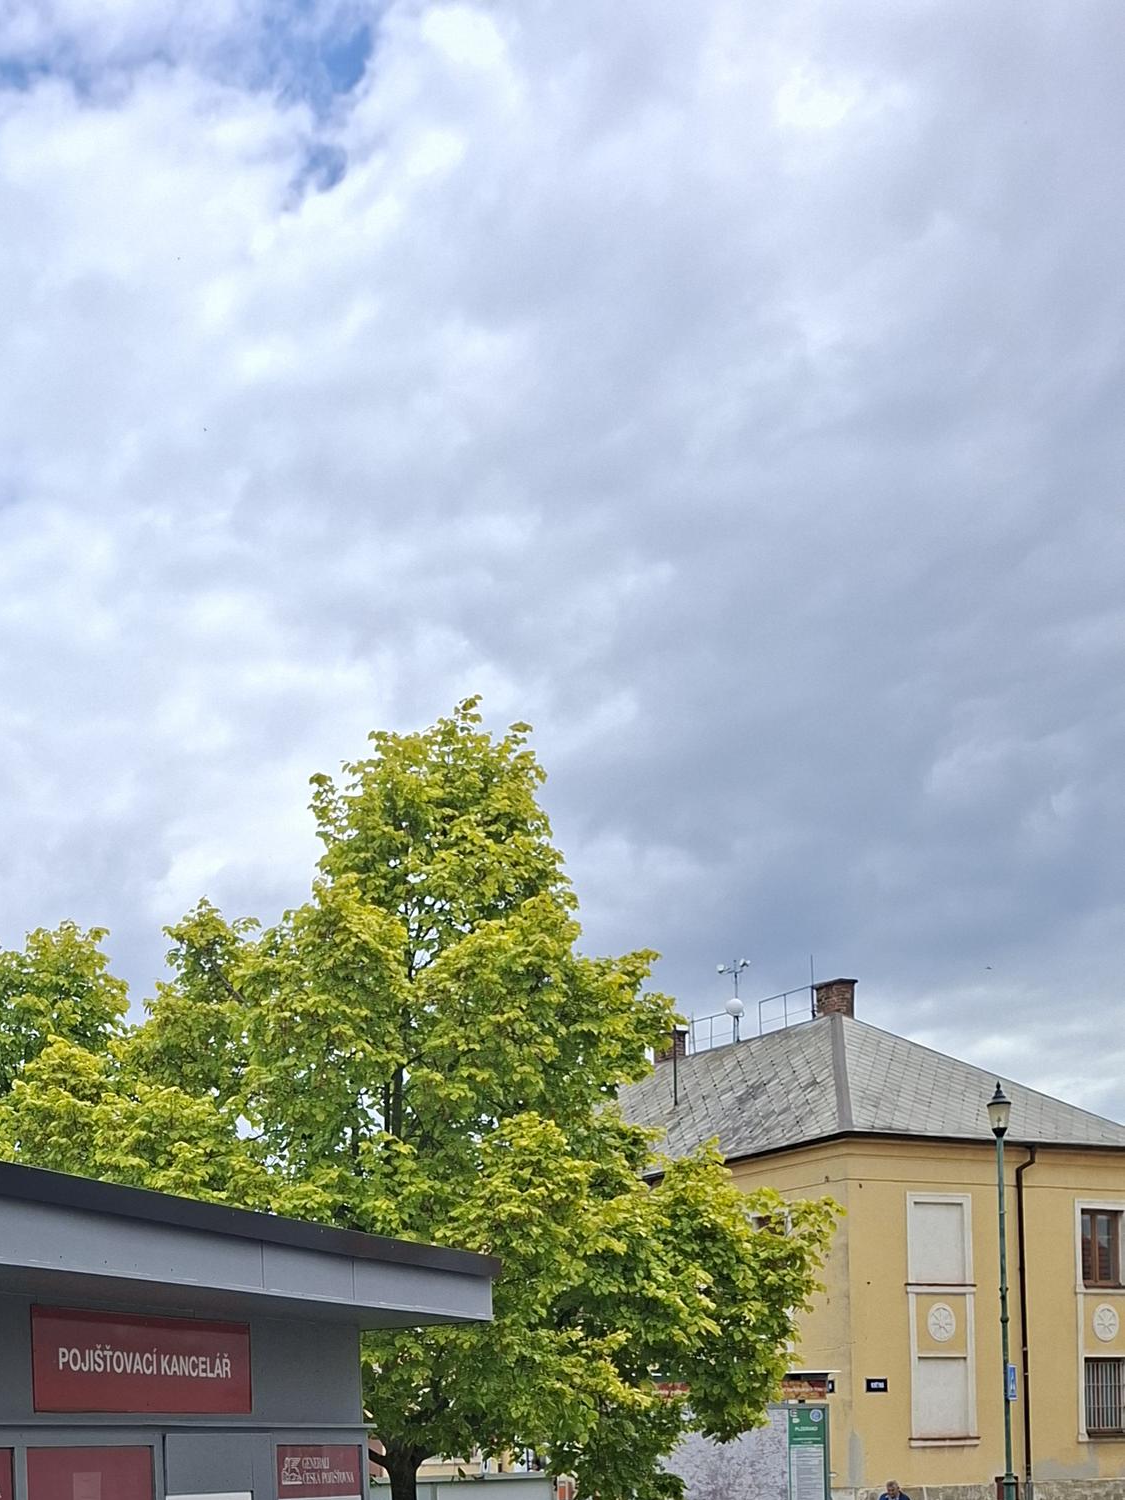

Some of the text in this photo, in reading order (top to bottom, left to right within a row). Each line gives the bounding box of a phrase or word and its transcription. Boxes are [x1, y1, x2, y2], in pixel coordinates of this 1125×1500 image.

[58, 1344, 232, 1378] POJIŠŤOVACÍ KANCELÁŘ
[302, 1457, 330, 1469] GENERALI
